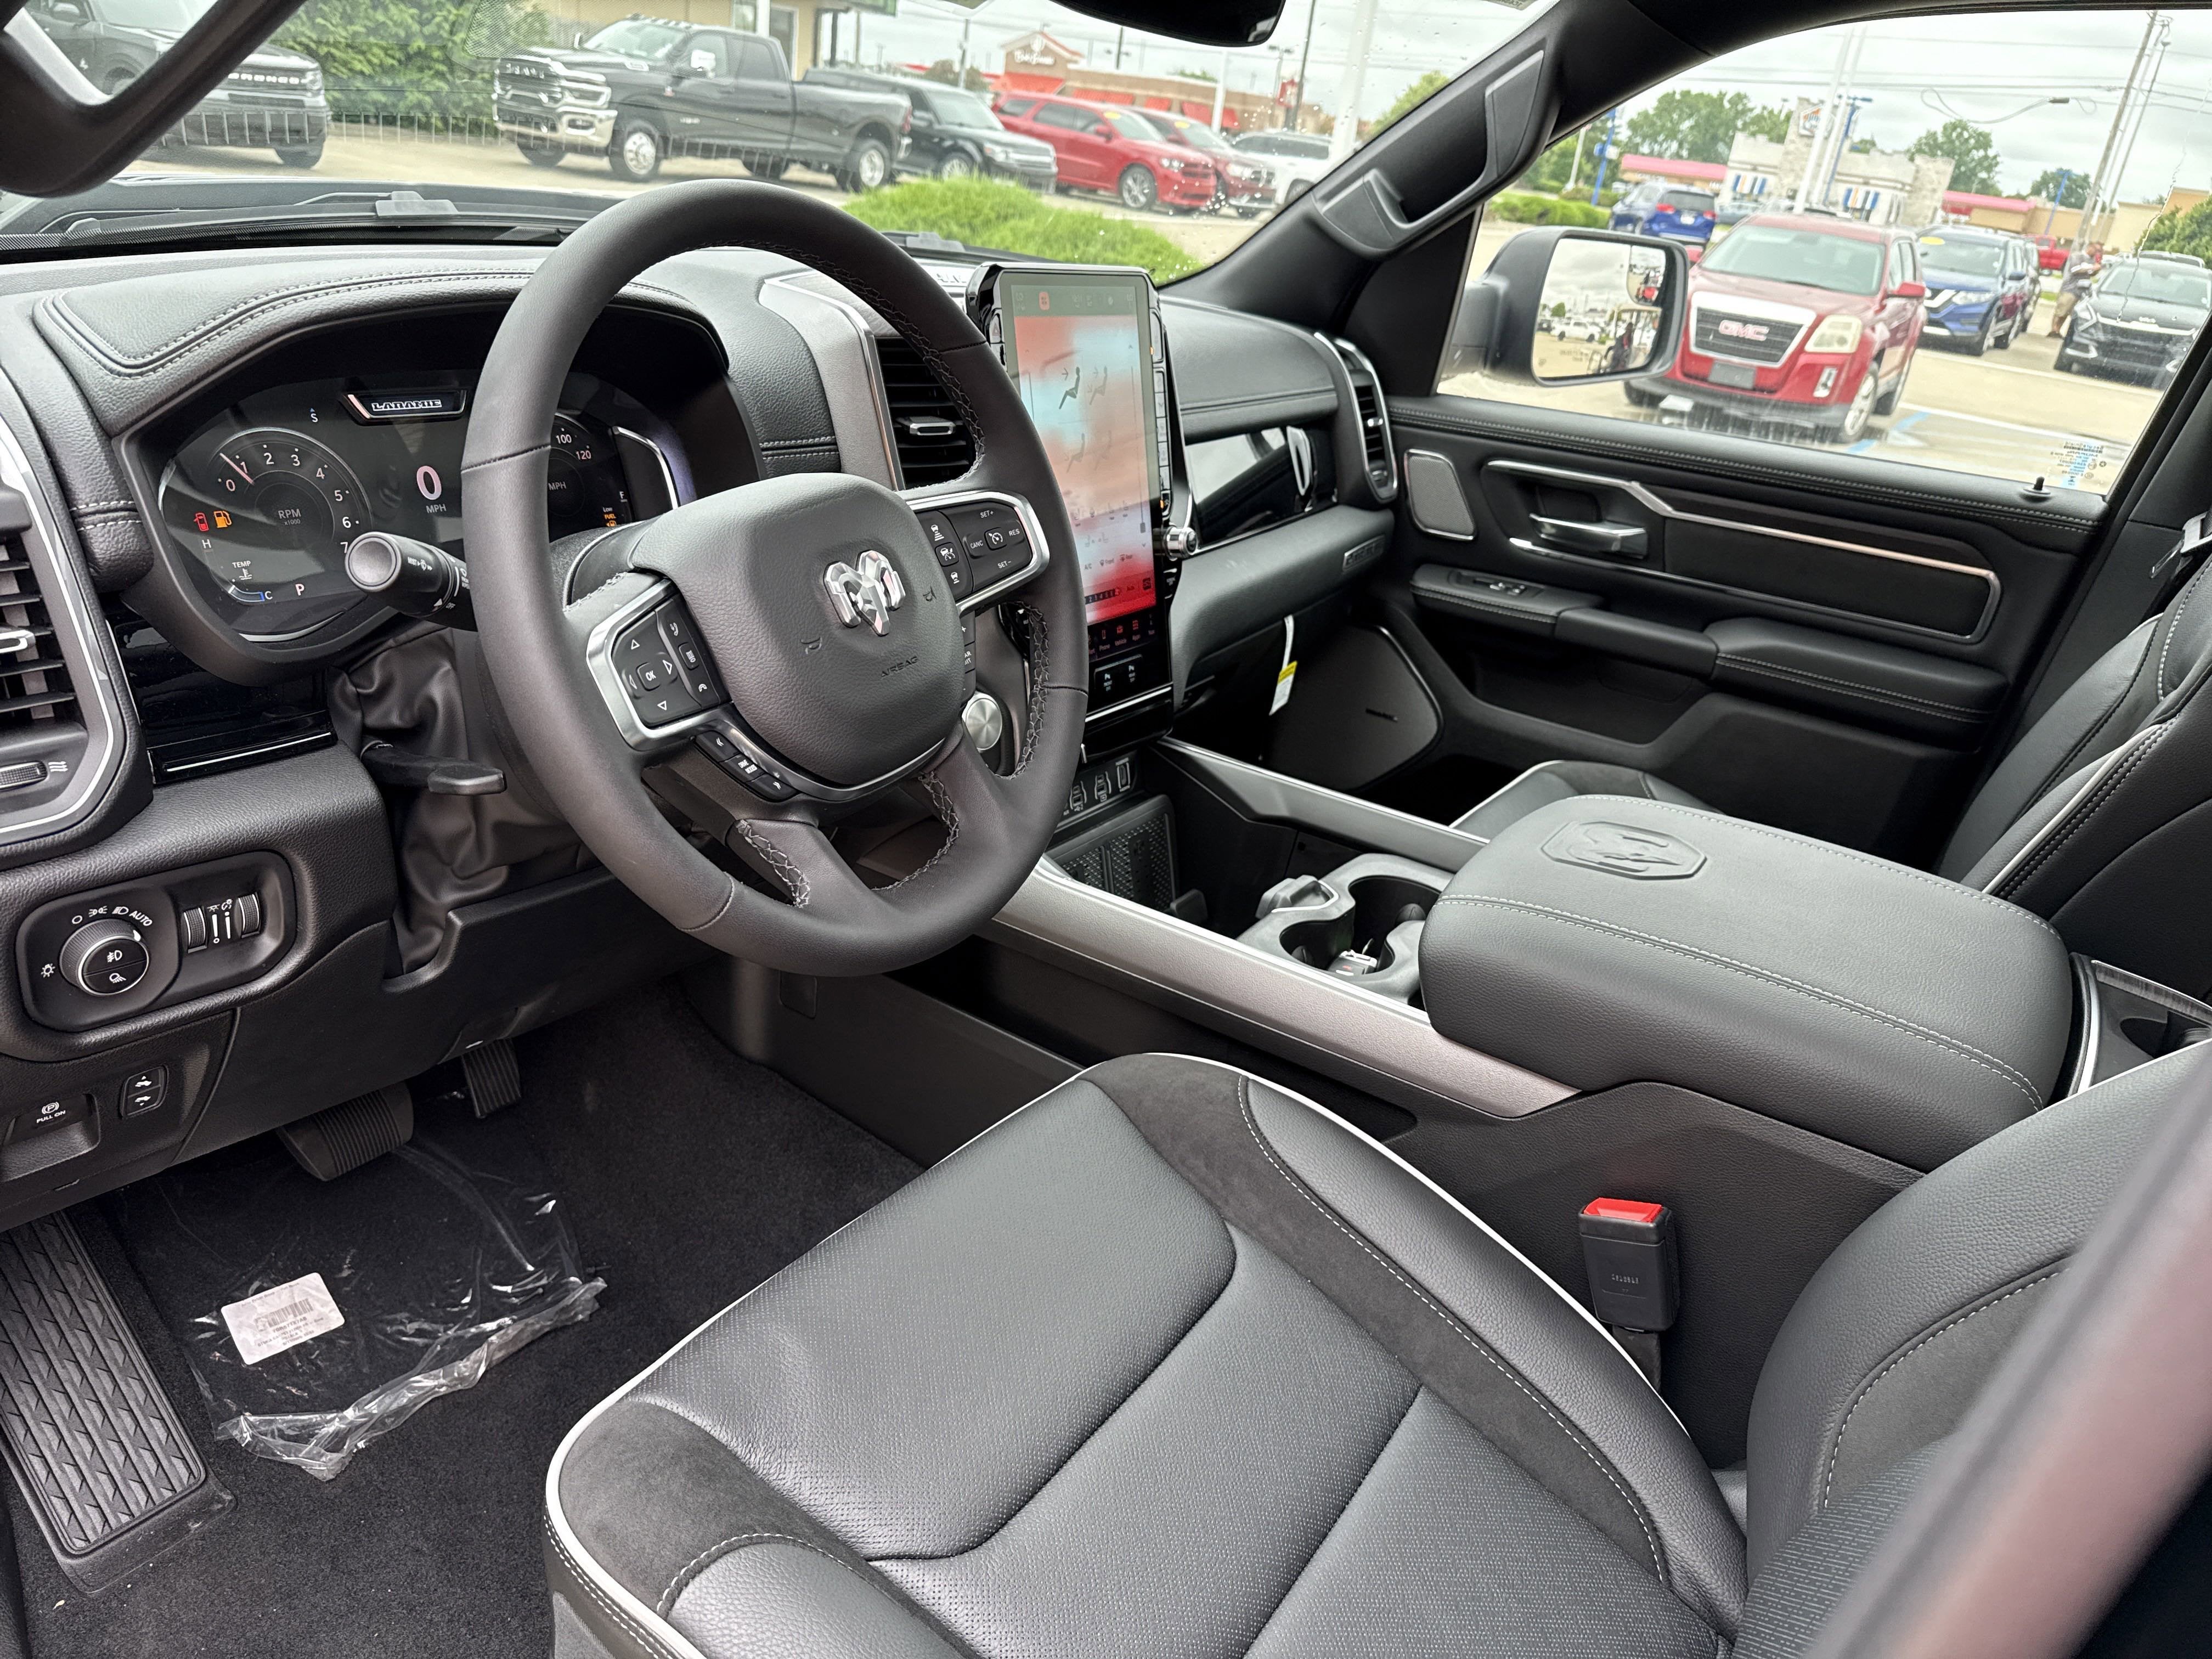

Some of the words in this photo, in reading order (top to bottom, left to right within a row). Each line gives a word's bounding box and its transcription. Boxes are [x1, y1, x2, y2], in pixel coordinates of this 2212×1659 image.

[1719, 320, 1769, 341] GMC
[371, 399, 442, 411] LARAMIE
[311, 413, 318, 422] S
[556, 434, 572, 444] 100
[263, 453, 274, 465] 2
[291, 454, 301, 466] 3
[576, 450, 591, 460] 120
[316, 468, 325, 479] 4
[226, 479, 236, 492] 0
[416, 466, 442, 500] 0
[549, 481, 567, 490] MPH
[334, 490, 343, 501] 5
[619, 491, 624, 499] F
[278, 509, 301, 519] RPM
[426, 503, 447, 514] MPH
[342, 516, 352, 528] 6
[1008, 528, 1020, 537] RES
[202, 539, 212, 549] H
[340, 541, 348, 554] 7
[970, 540, 984, 549] CANC
[264, 591, 273, 600] C
[295, 584, 304, 596] P
[881, 656, 918, 678] AIRBAG
[645, 670, 656, 681] OK
[128, 910, 153, 926] AUTO
[36, 1115, 53, 1124] PULL
